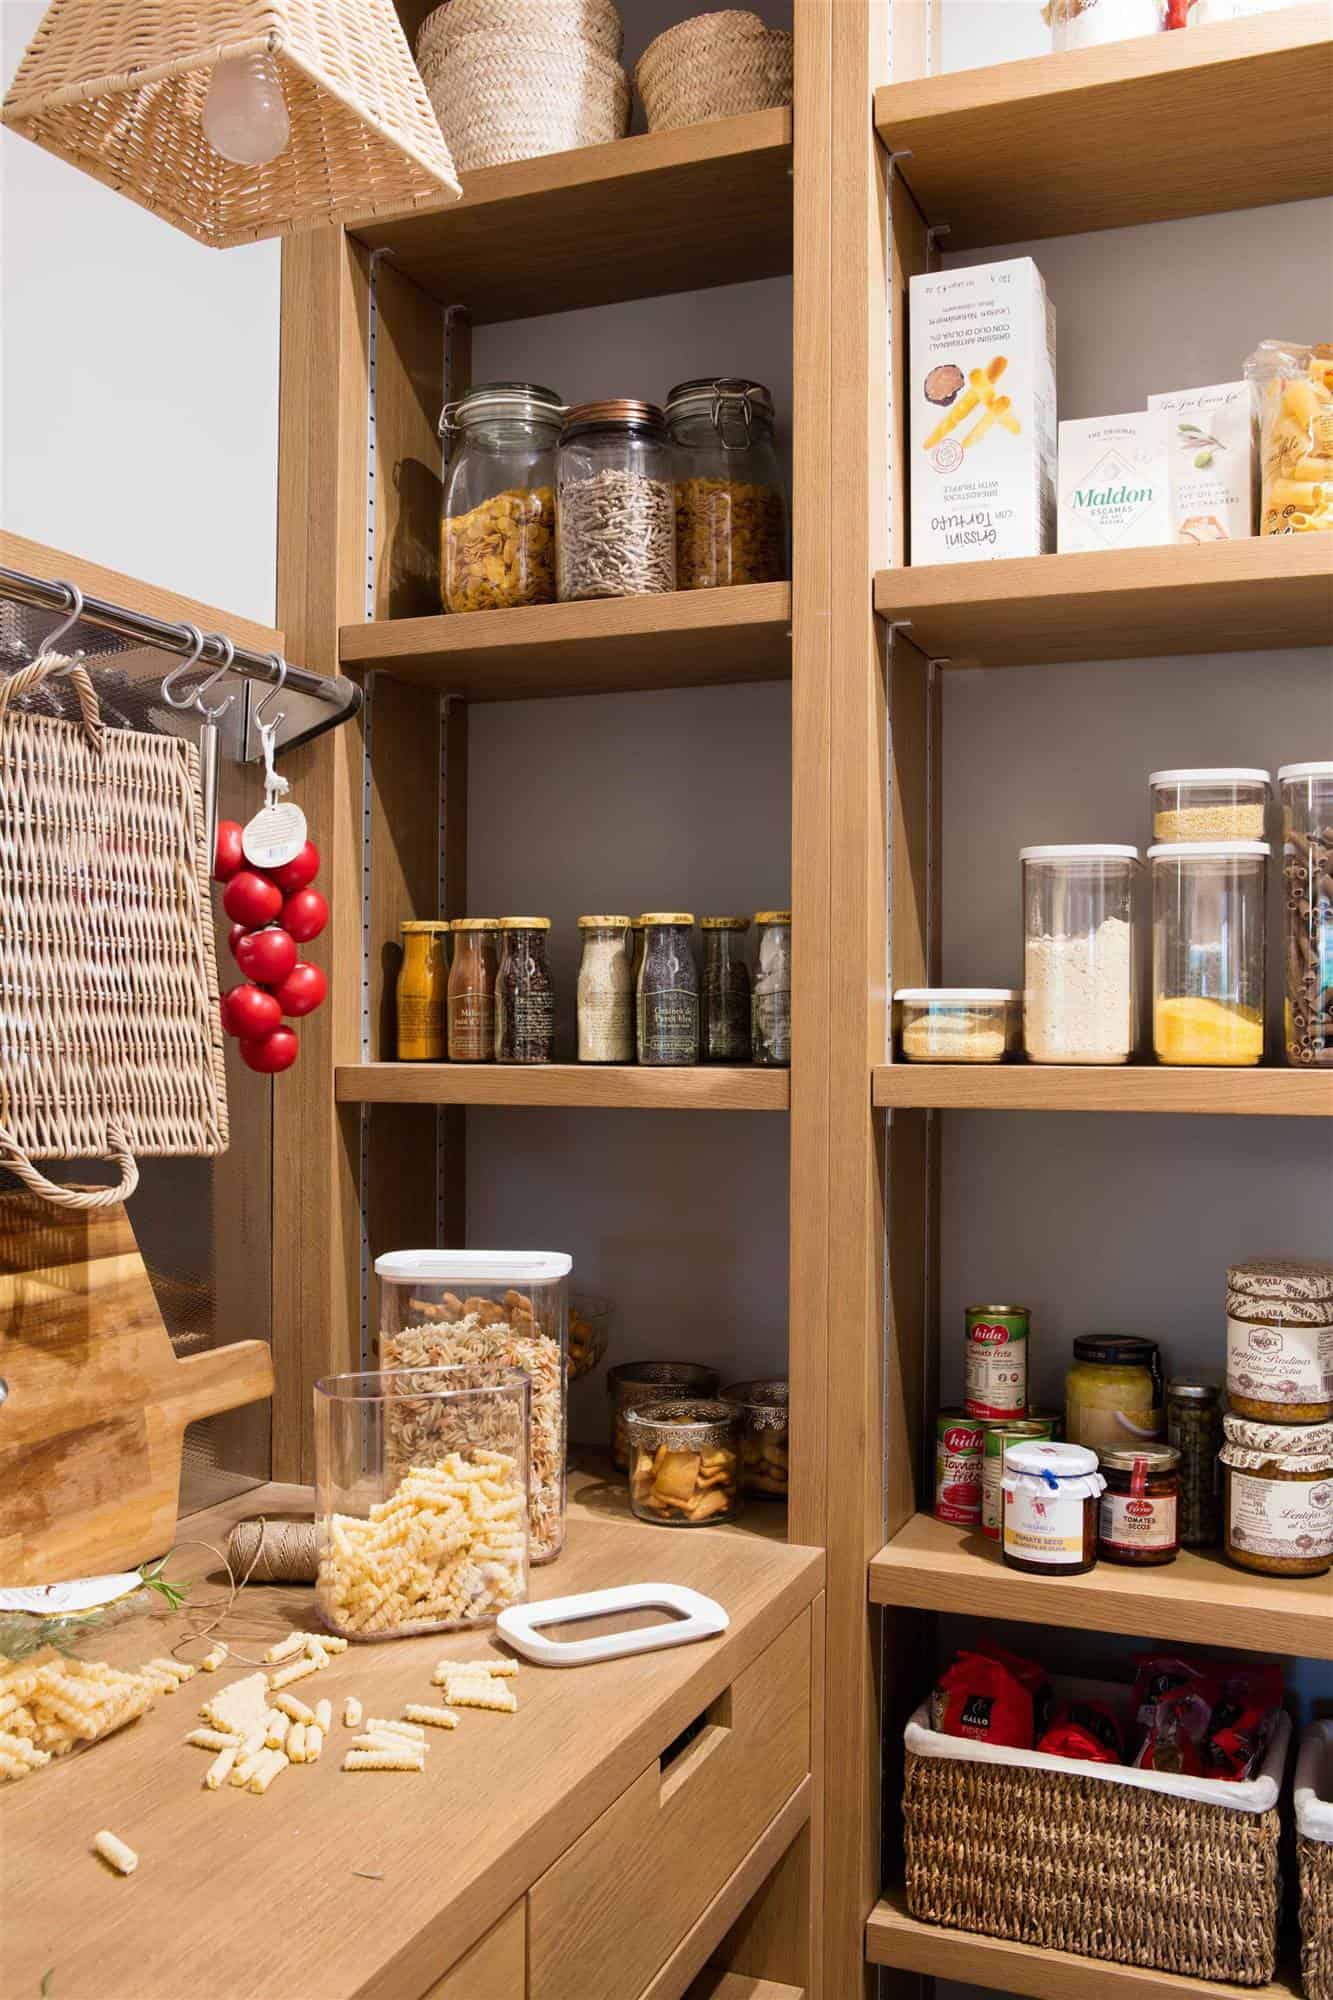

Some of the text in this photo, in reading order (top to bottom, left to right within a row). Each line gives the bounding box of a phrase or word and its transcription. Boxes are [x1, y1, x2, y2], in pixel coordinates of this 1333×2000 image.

[943, 489, 998, 503] BREADSTICKS
[1073, 486, 1152, 509] Maldon
[1090, 506, 1134, 516] ESCAMAS
[931, 512, 993, 531] Tartufo
[945, 528, 997, 549] Grissini
[1123, 1515, 1156, 1524] TOMATES
[1016, 1533, 1041, 1544] TOMATE
[962, 1714, 989, 1726] GALLO
